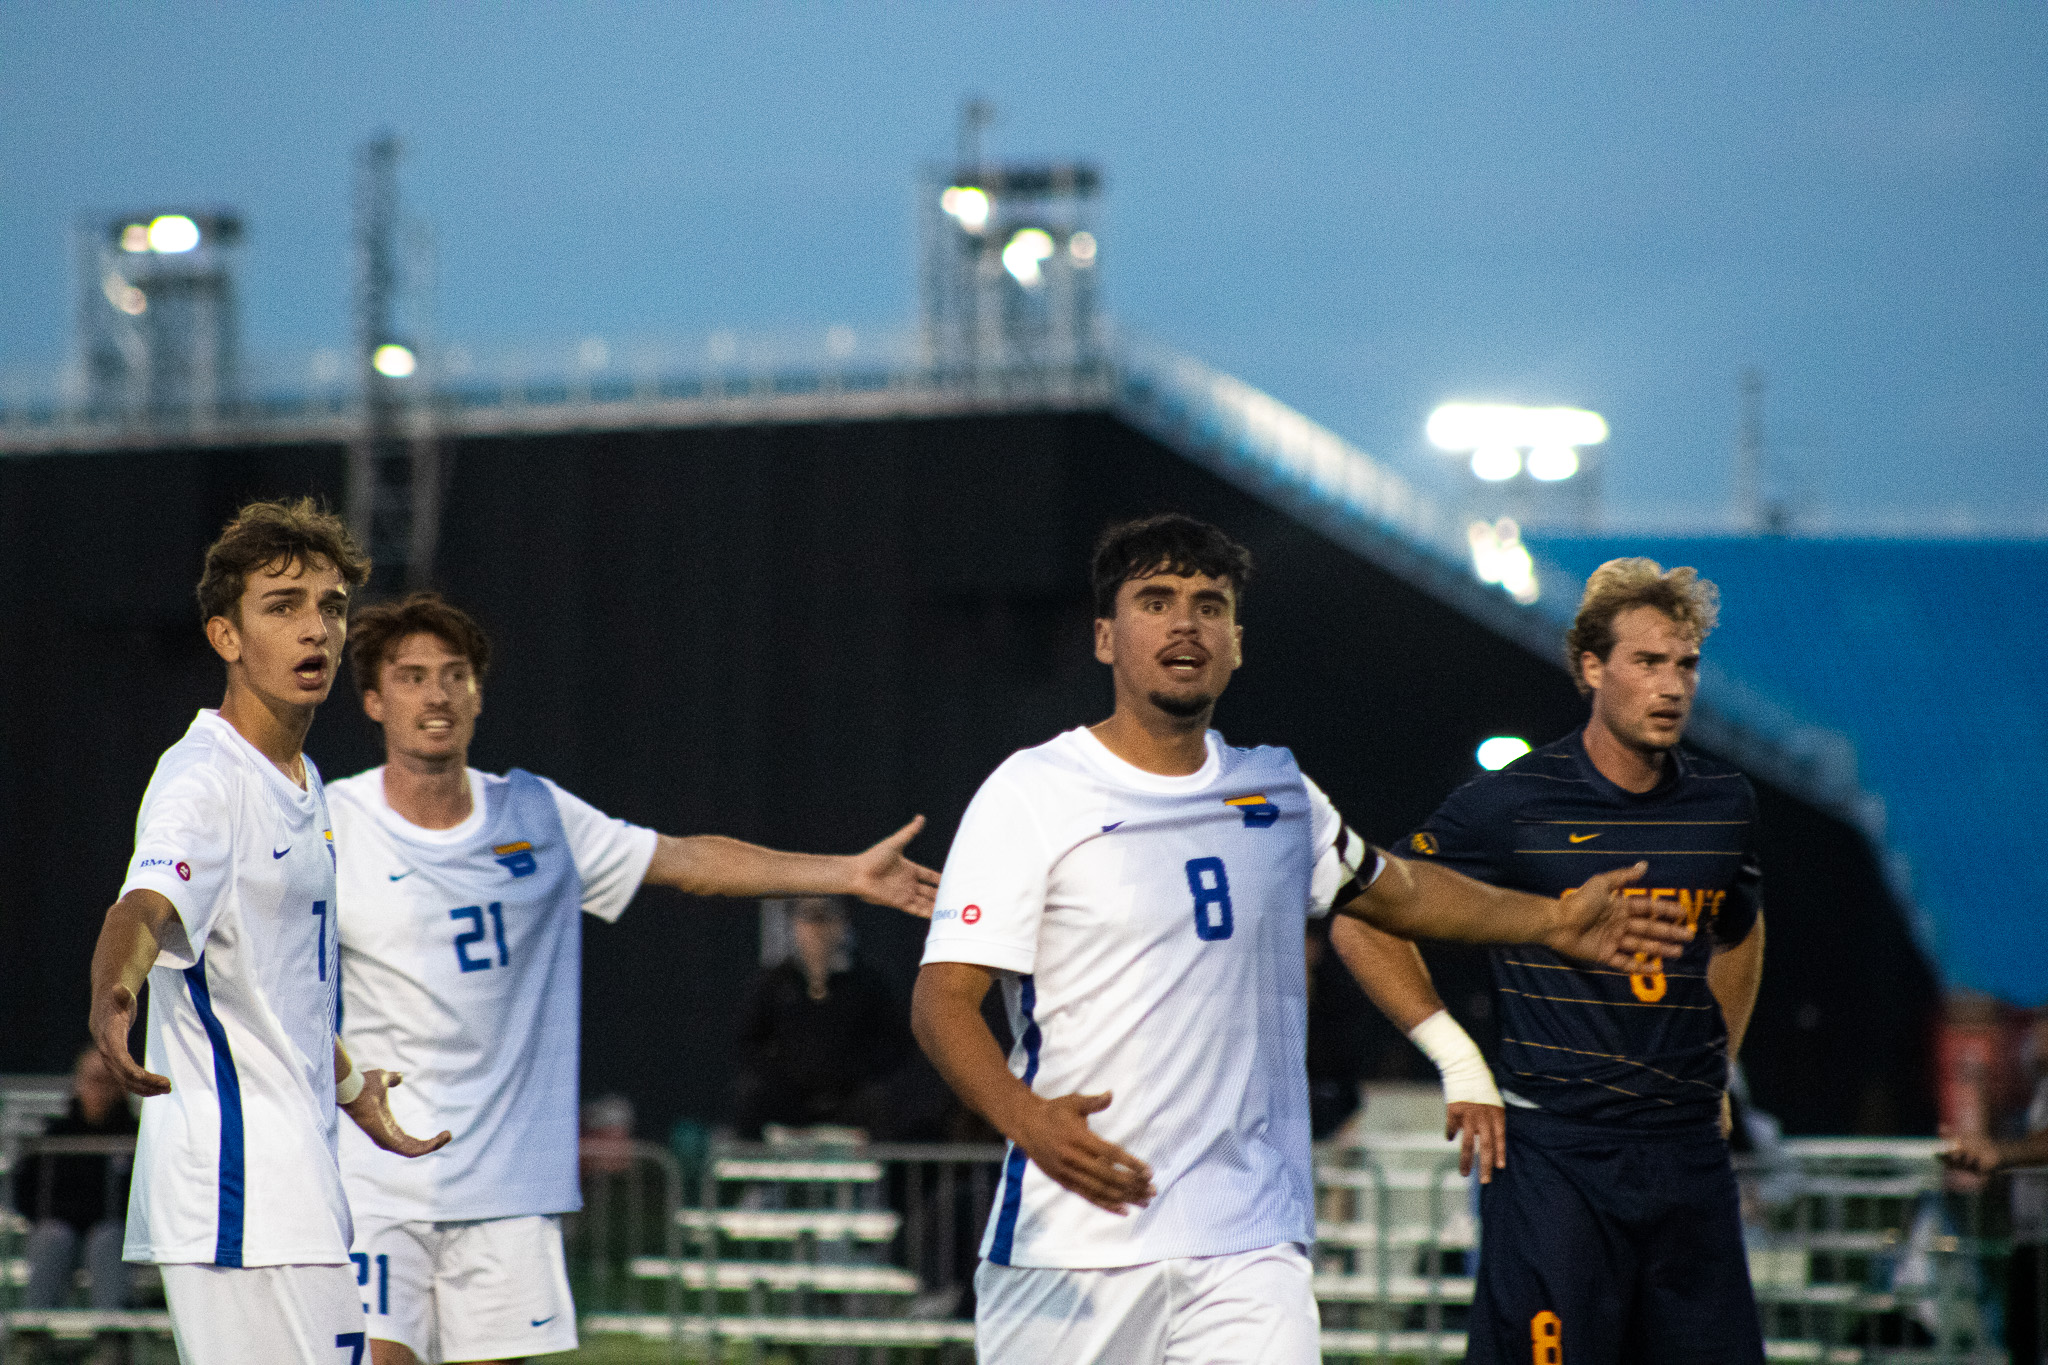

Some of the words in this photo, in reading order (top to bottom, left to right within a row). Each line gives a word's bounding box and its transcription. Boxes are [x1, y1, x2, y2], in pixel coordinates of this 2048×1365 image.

[1185, 857, 1235, 942] 8
[449, 901, 509, 973] 21
[1530, 1310, 1563, 1365] 8
